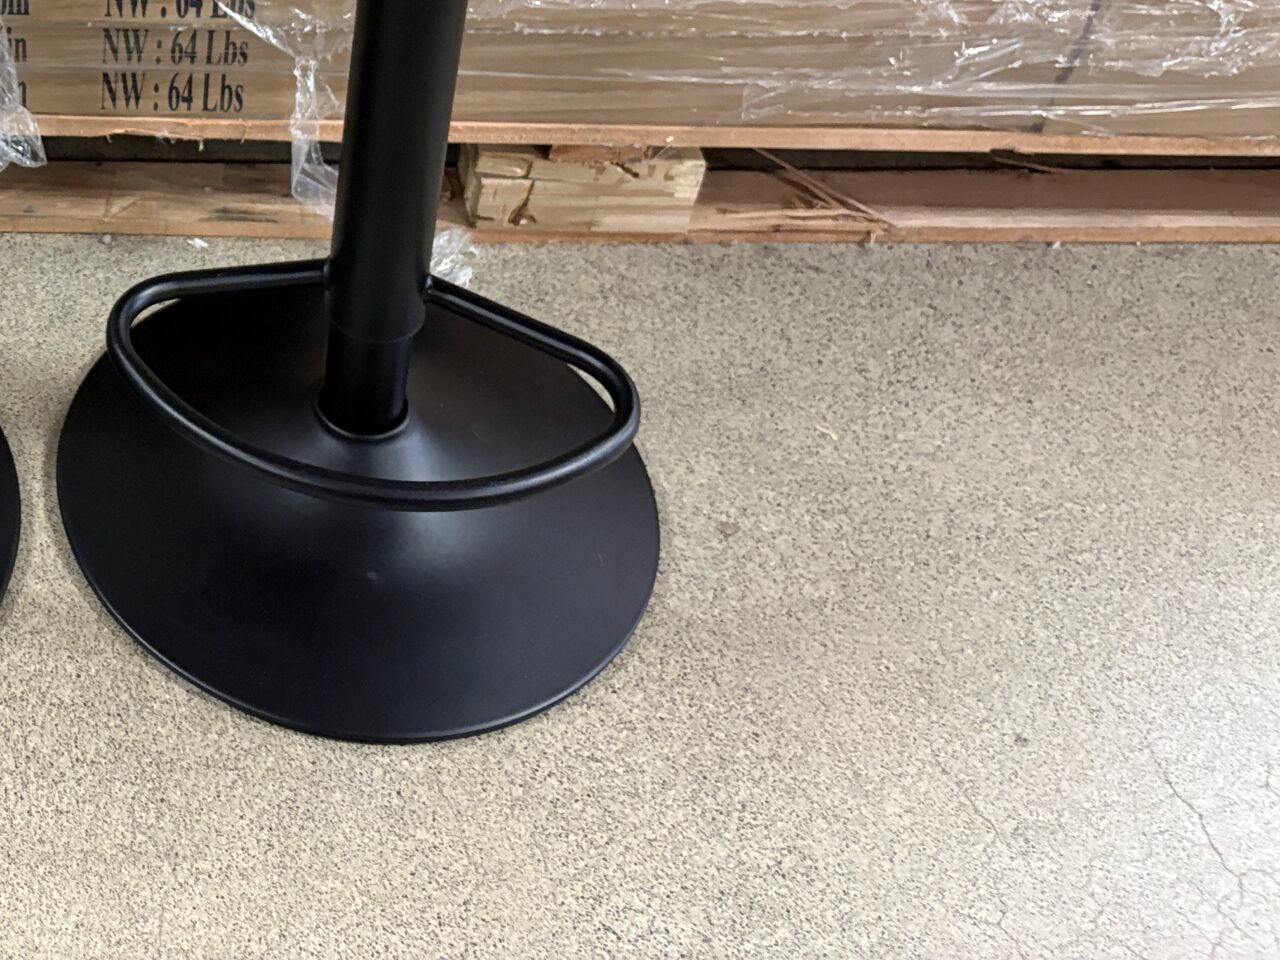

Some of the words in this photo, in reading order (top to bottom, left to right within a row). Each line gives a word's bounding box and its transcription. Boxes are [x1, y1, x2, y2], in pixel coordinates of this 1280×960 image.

[171, 28, 198, 66] 64
[205, 29, 249, 66] Lbs
[167, 71, 194, 112] 64
[201, 72, 245, 113] Lbs
